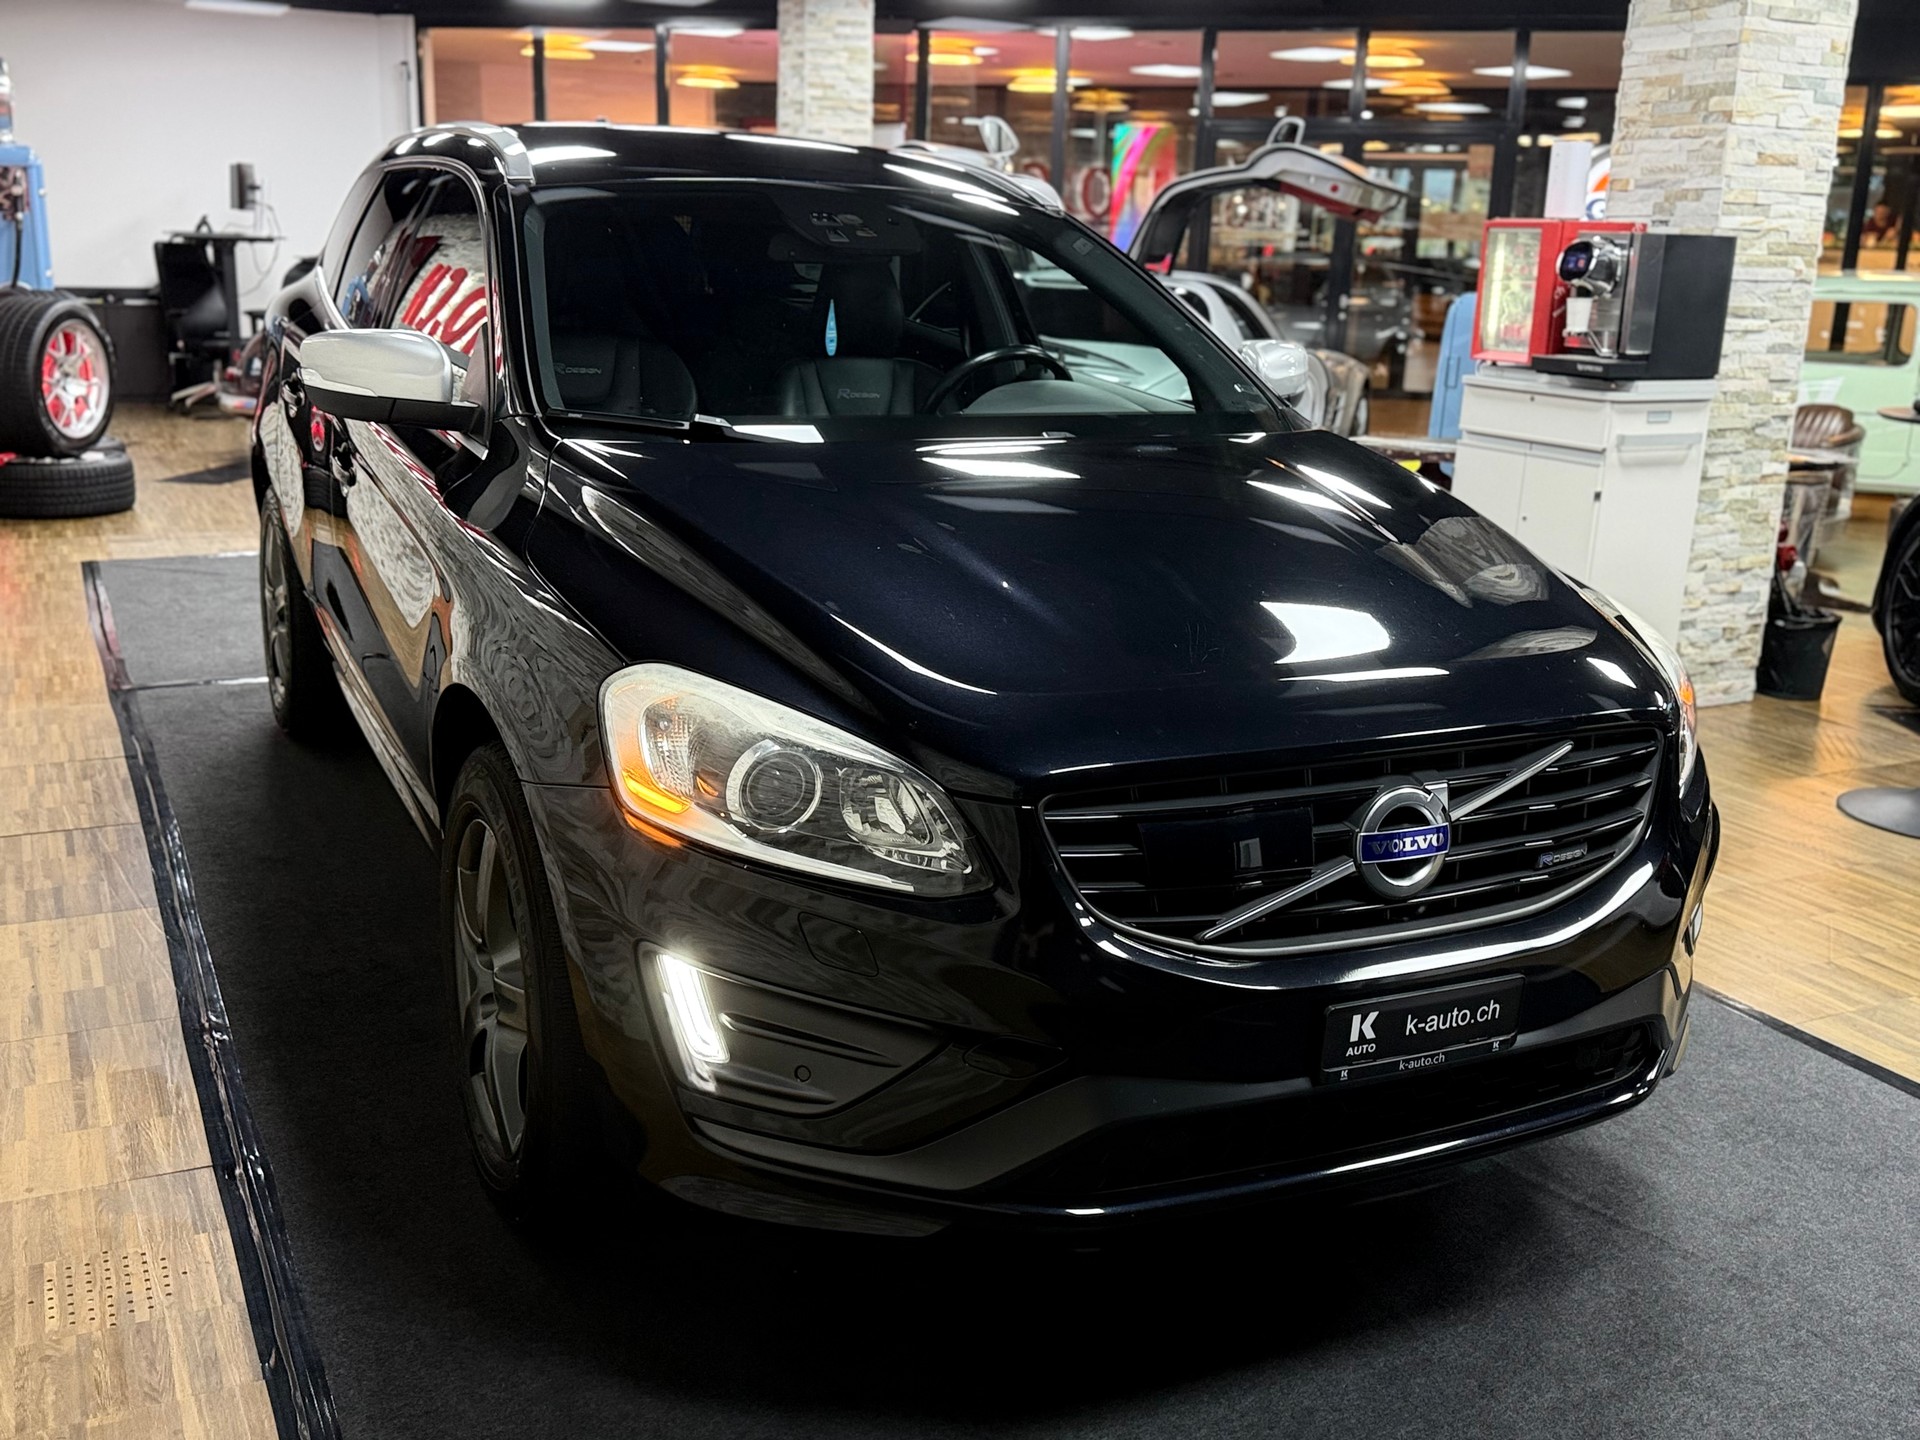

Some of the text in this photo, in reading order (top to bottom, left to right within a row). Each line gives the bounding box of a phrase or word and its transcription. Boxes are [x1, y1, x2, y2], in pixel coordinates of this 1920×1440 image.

[1369, 832, 1445, 855] VOLVO
[1349, 1011, 1380, 1043] K
[1405, 1000, 1500, 1036] k-auto.ch
[1346, 1043, 1376, 1057] AUTO
[1399, 1053, 1446, 1071] k-auto.ch
